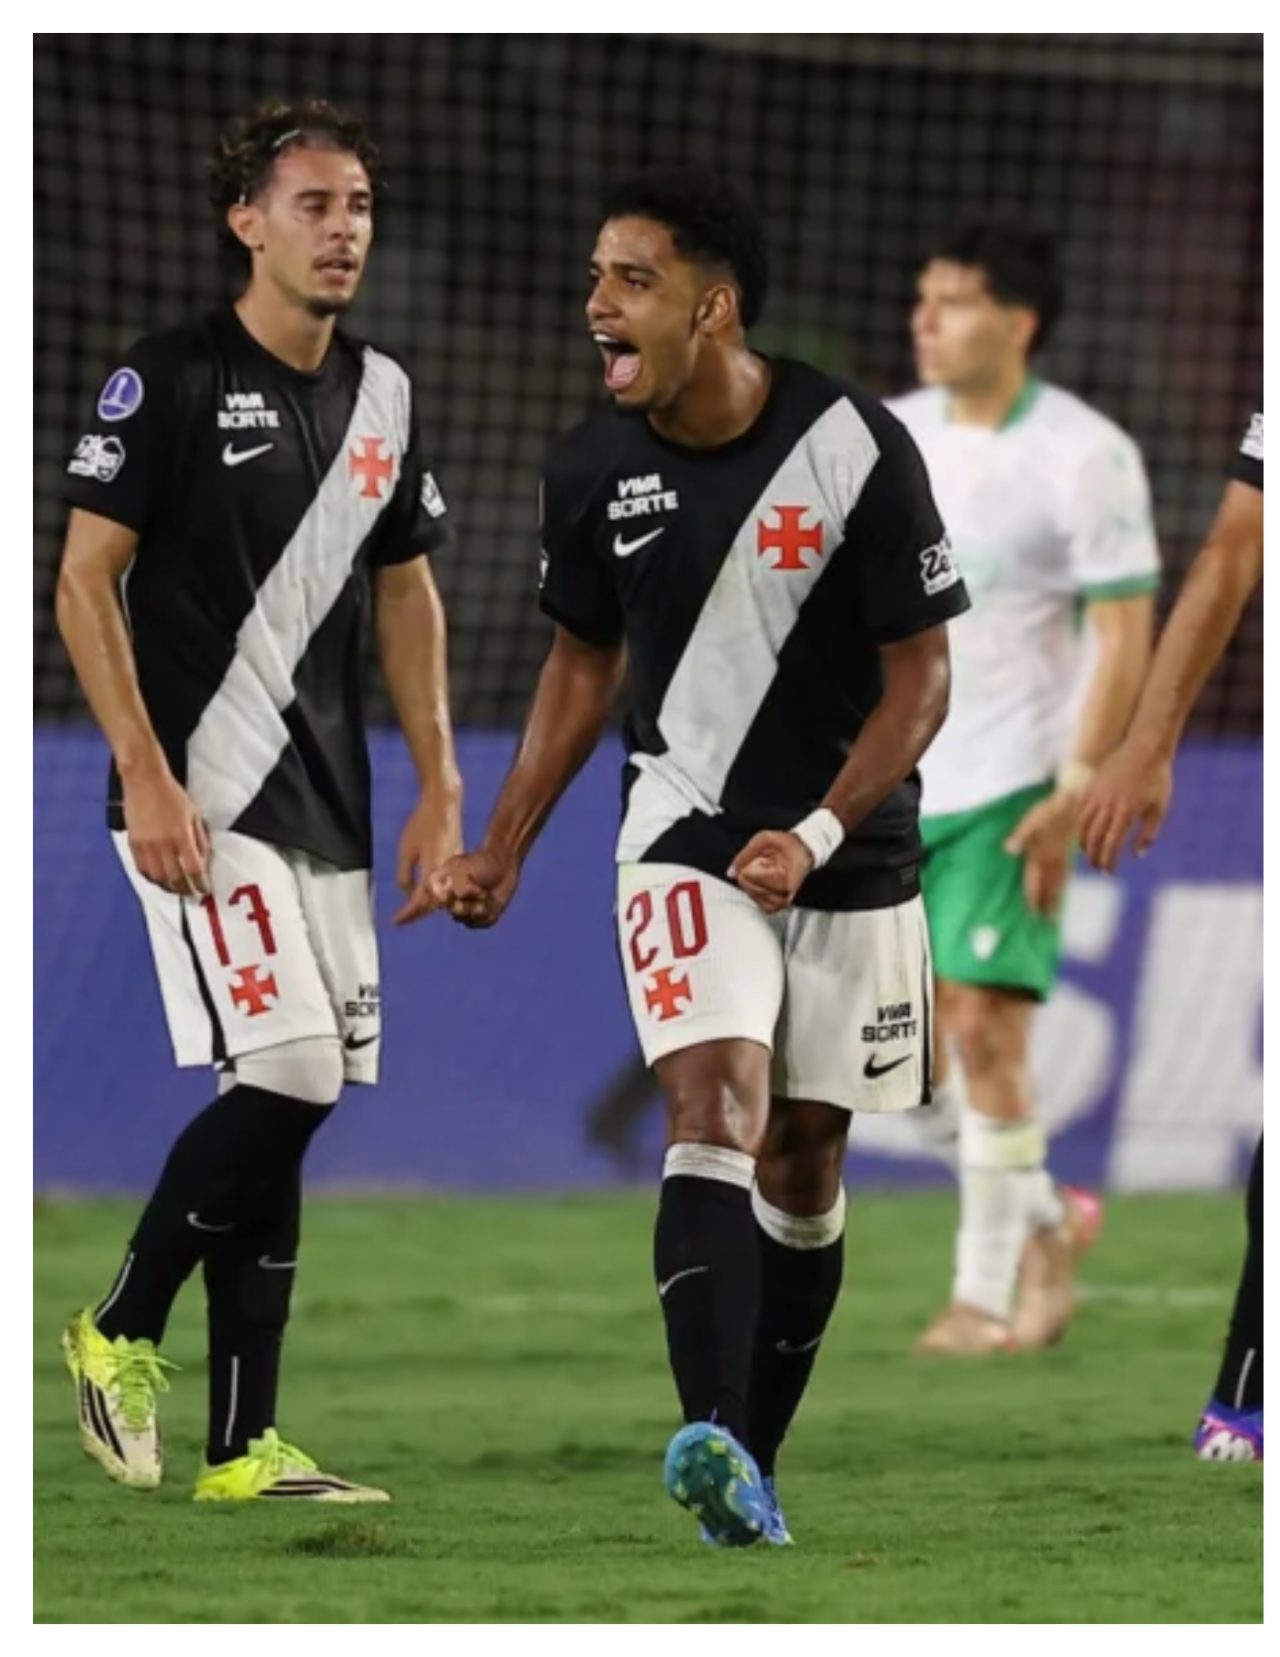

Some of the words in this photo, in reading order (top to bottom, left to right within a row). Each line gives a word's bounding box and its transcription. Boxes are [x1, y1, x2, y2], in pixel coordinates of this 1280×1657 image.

[226, 392, 264, 410] VIVA
[217, 410, 280, 428] SORTE
[618, 473, 662, 498] VIVA
[607, 491, 679, 520] SORTE
[200, 884, 276, 968] 17
[626, 880, 709, 972] 20
[876, 1002, 912, 1023] VIVA
